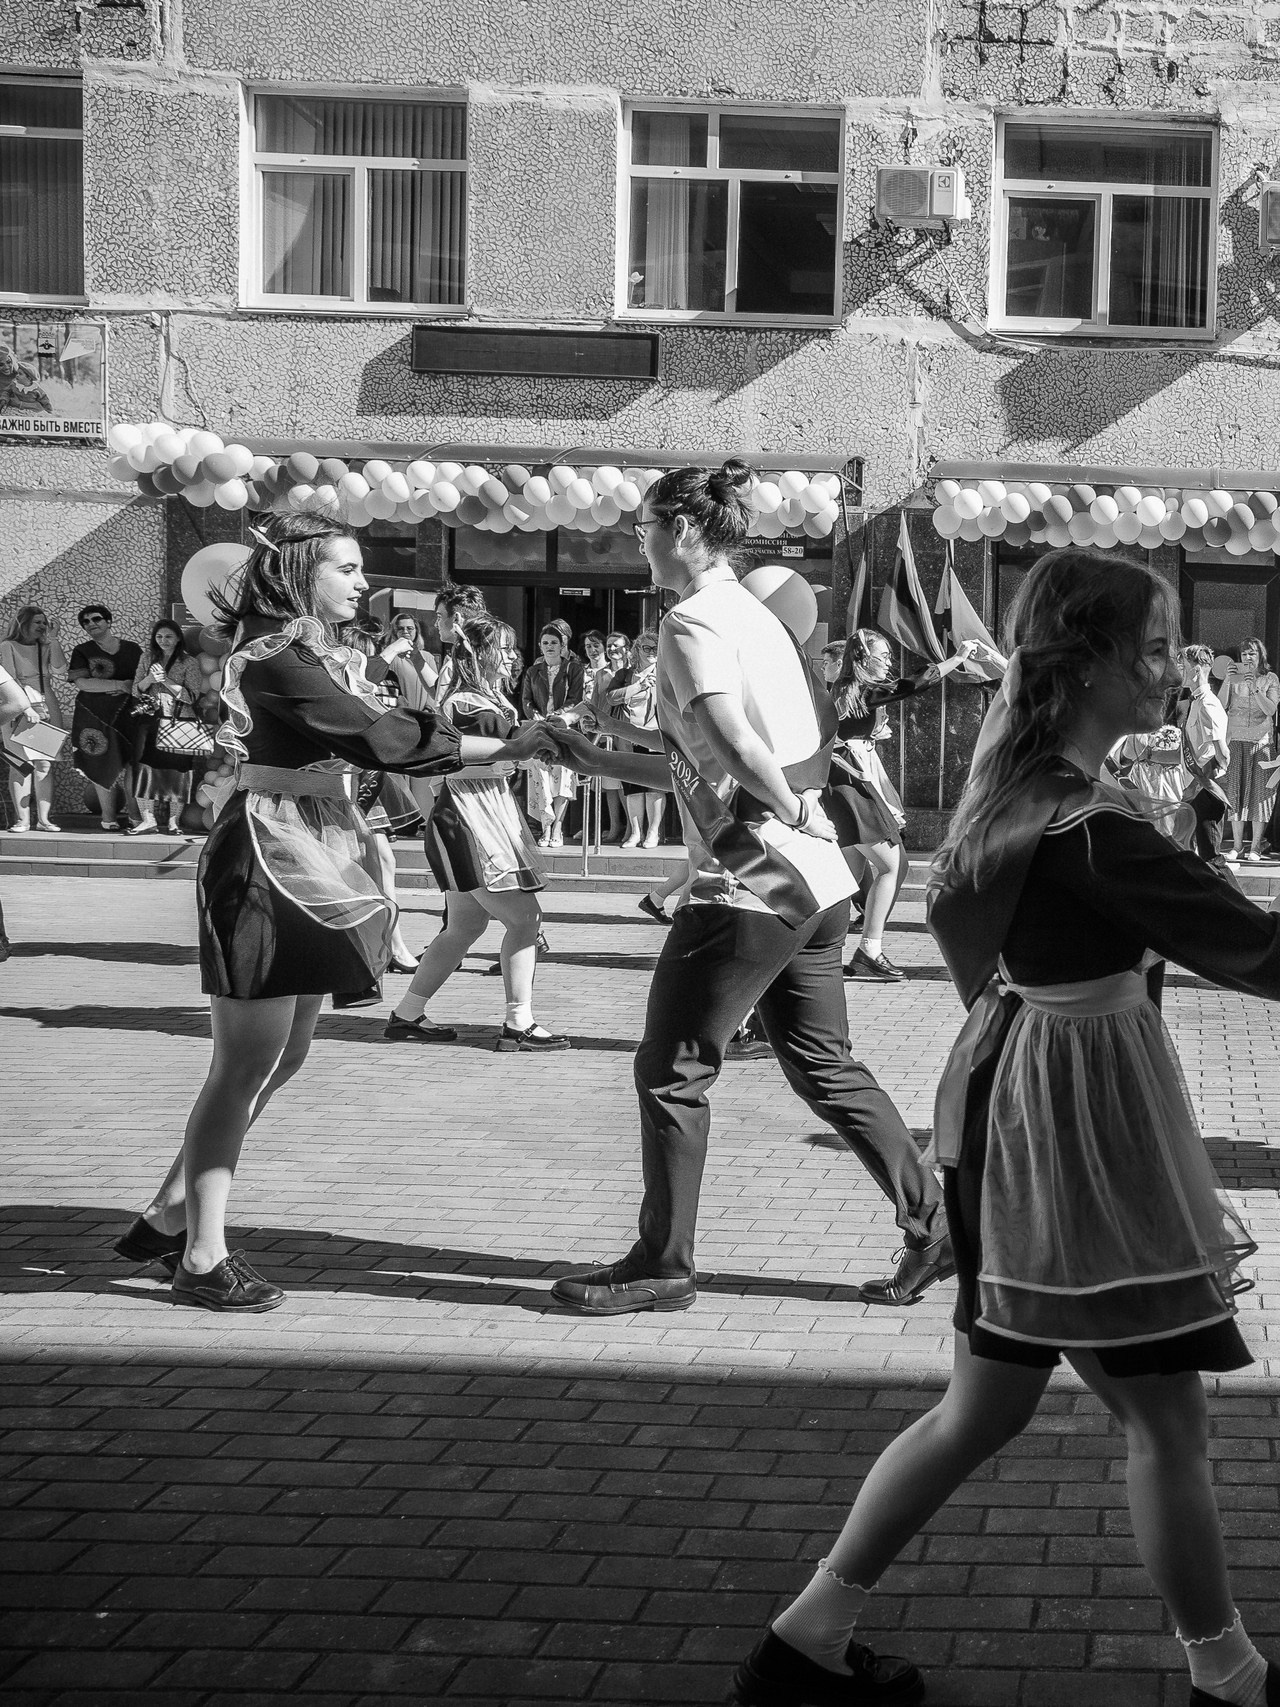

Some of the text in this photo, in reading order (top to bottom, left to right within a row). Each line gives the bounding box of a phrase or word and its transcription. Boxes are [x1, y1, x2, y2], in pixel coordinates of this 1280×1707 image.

[0, 418, 102, 434] АЖНО БЫТЬ ВМЕСТЕ
[668, 751, 700, 796] 2024
